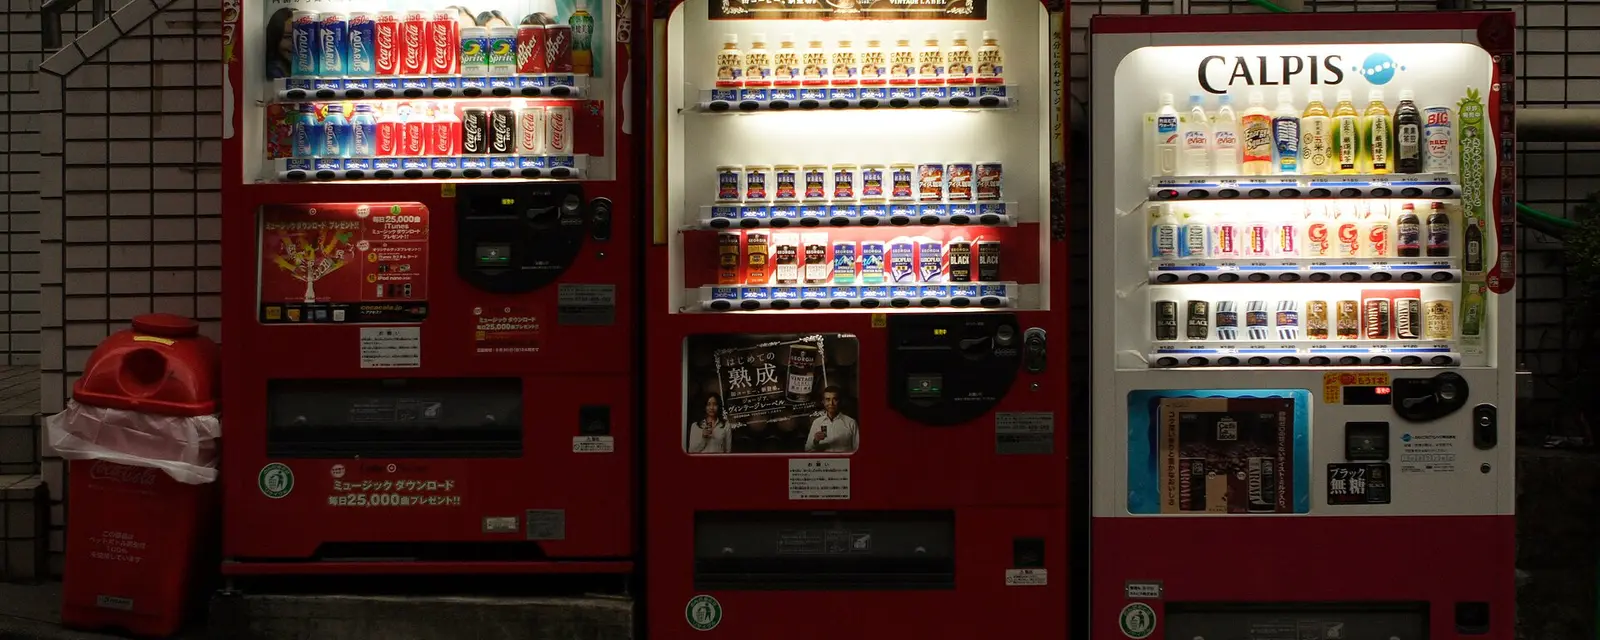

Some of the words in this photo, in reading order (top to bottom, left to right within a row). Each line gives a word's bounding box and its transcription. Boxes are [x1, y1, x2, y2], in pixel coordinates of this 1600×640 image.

[299, 29, 308, 72] AQUARIUS
[324, 29, 335, 72] AQUARIUS
[352, 30, 361, 72] AQUARIUS
[517, 35, 536, 70] Pepper
[461, 54, 484, 64] Sprite
[490, 54, 514, 64] Sprite
[1198, 54, 1344, 94] CALPIS
[1053, 31, 1062, 140] 気分に合わせてジョージア
[1428, 112, 1448, 124] BIG
[1187, 136, 1206, 145] evian
[1217, 136, 1236, 145] evian
[1160, 228, 1174, 248] DIET
[1190, 228, 1204, 248] DIET
[950, 256, 970, 265] BLACK
[980, 256, 998, 264] BLACK
[726, 352, 774, 366] はじめての
[728, 363, 778, 390] 熟成
[1330, 468, 1366, 478] ブラック
[334, 480, 392, 491] ミュージック
[396, 480, 455, 491] ダウンロード
[1330, 478, 1366, 495] 無糖
